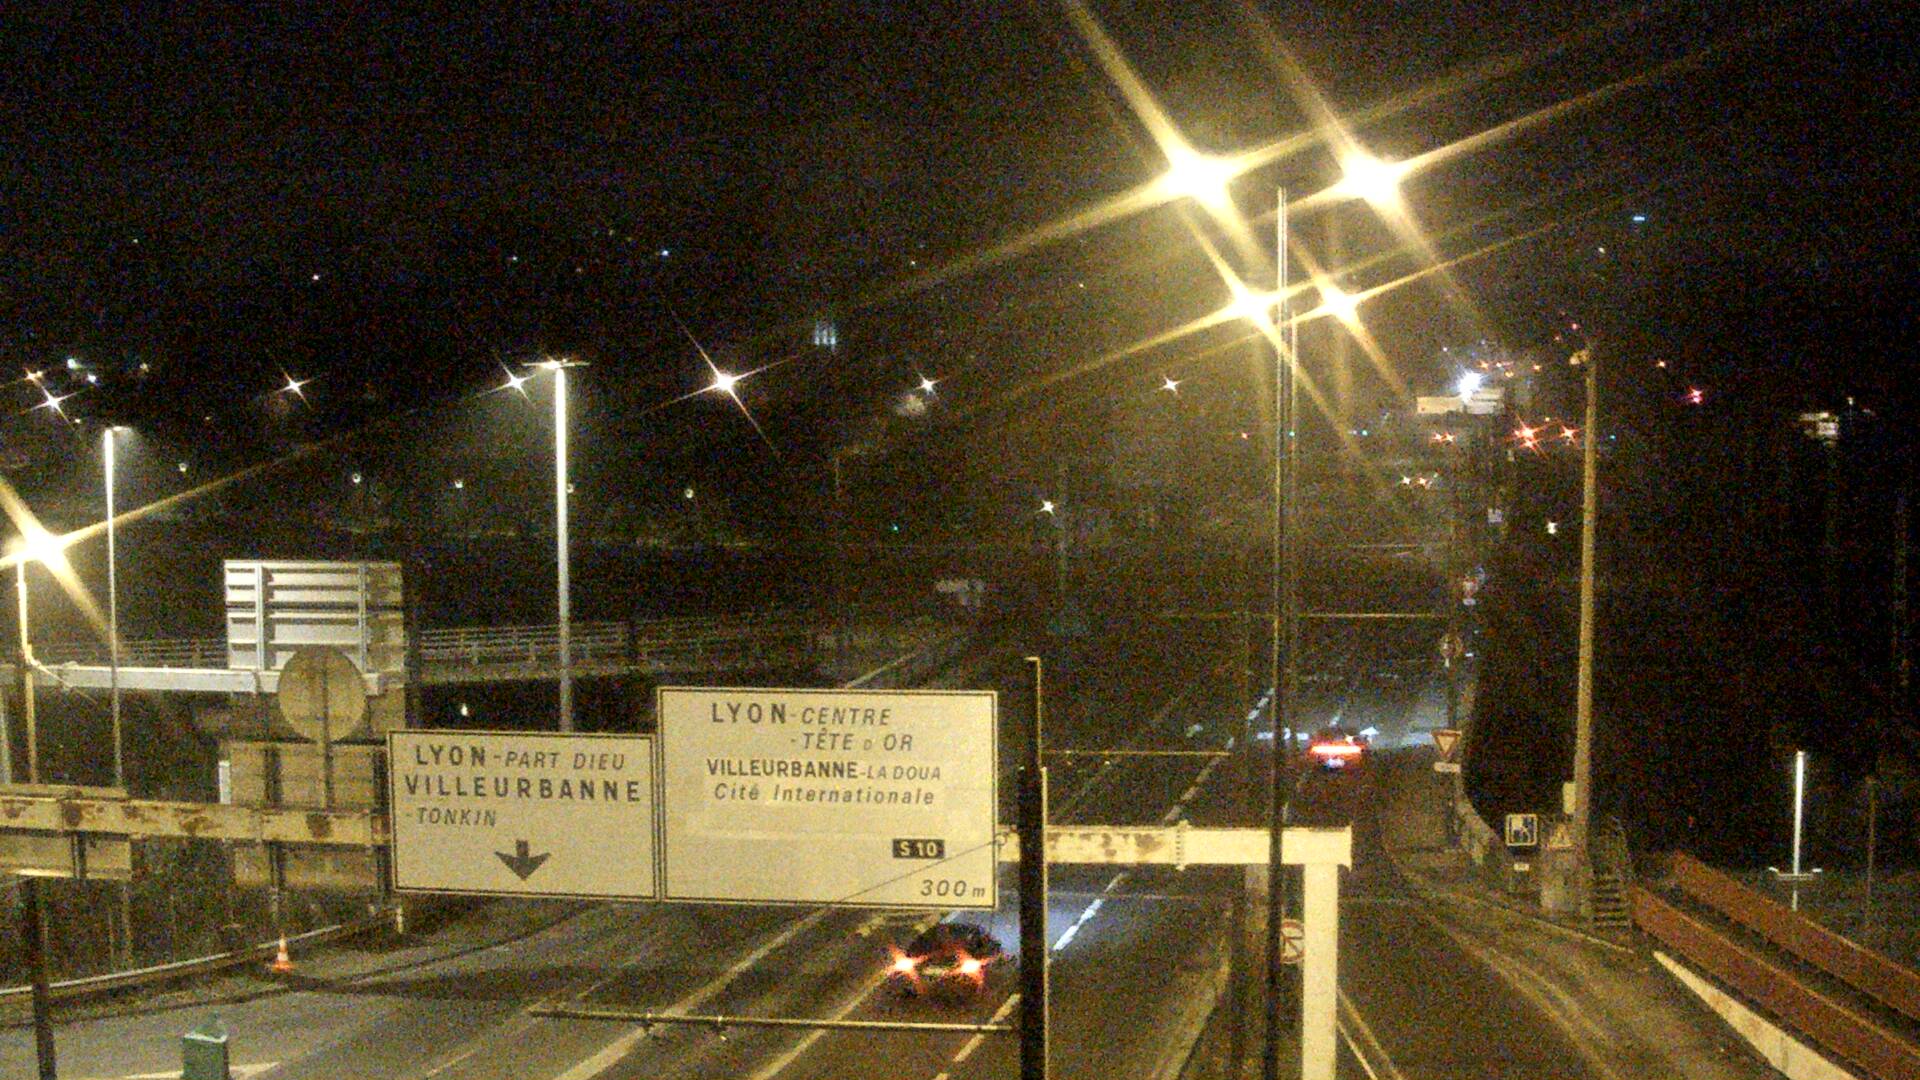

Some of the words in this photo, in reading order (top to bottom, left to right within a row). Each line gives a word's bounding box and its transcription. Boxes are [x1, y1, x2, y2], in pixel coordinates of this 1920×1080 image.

[884, 733, 913, 751] OR
[573, 753, 625, 770] DIEU
[893, 765, 941, 781] DOUA
[405, 774, 641, 803] VILLEURBANNE
[714, 783, 760, 800] Cité
[773, 784, 934, 805] Internationale
[921, 879, 967, 897] 300
[972, 887, 986, 898] m
